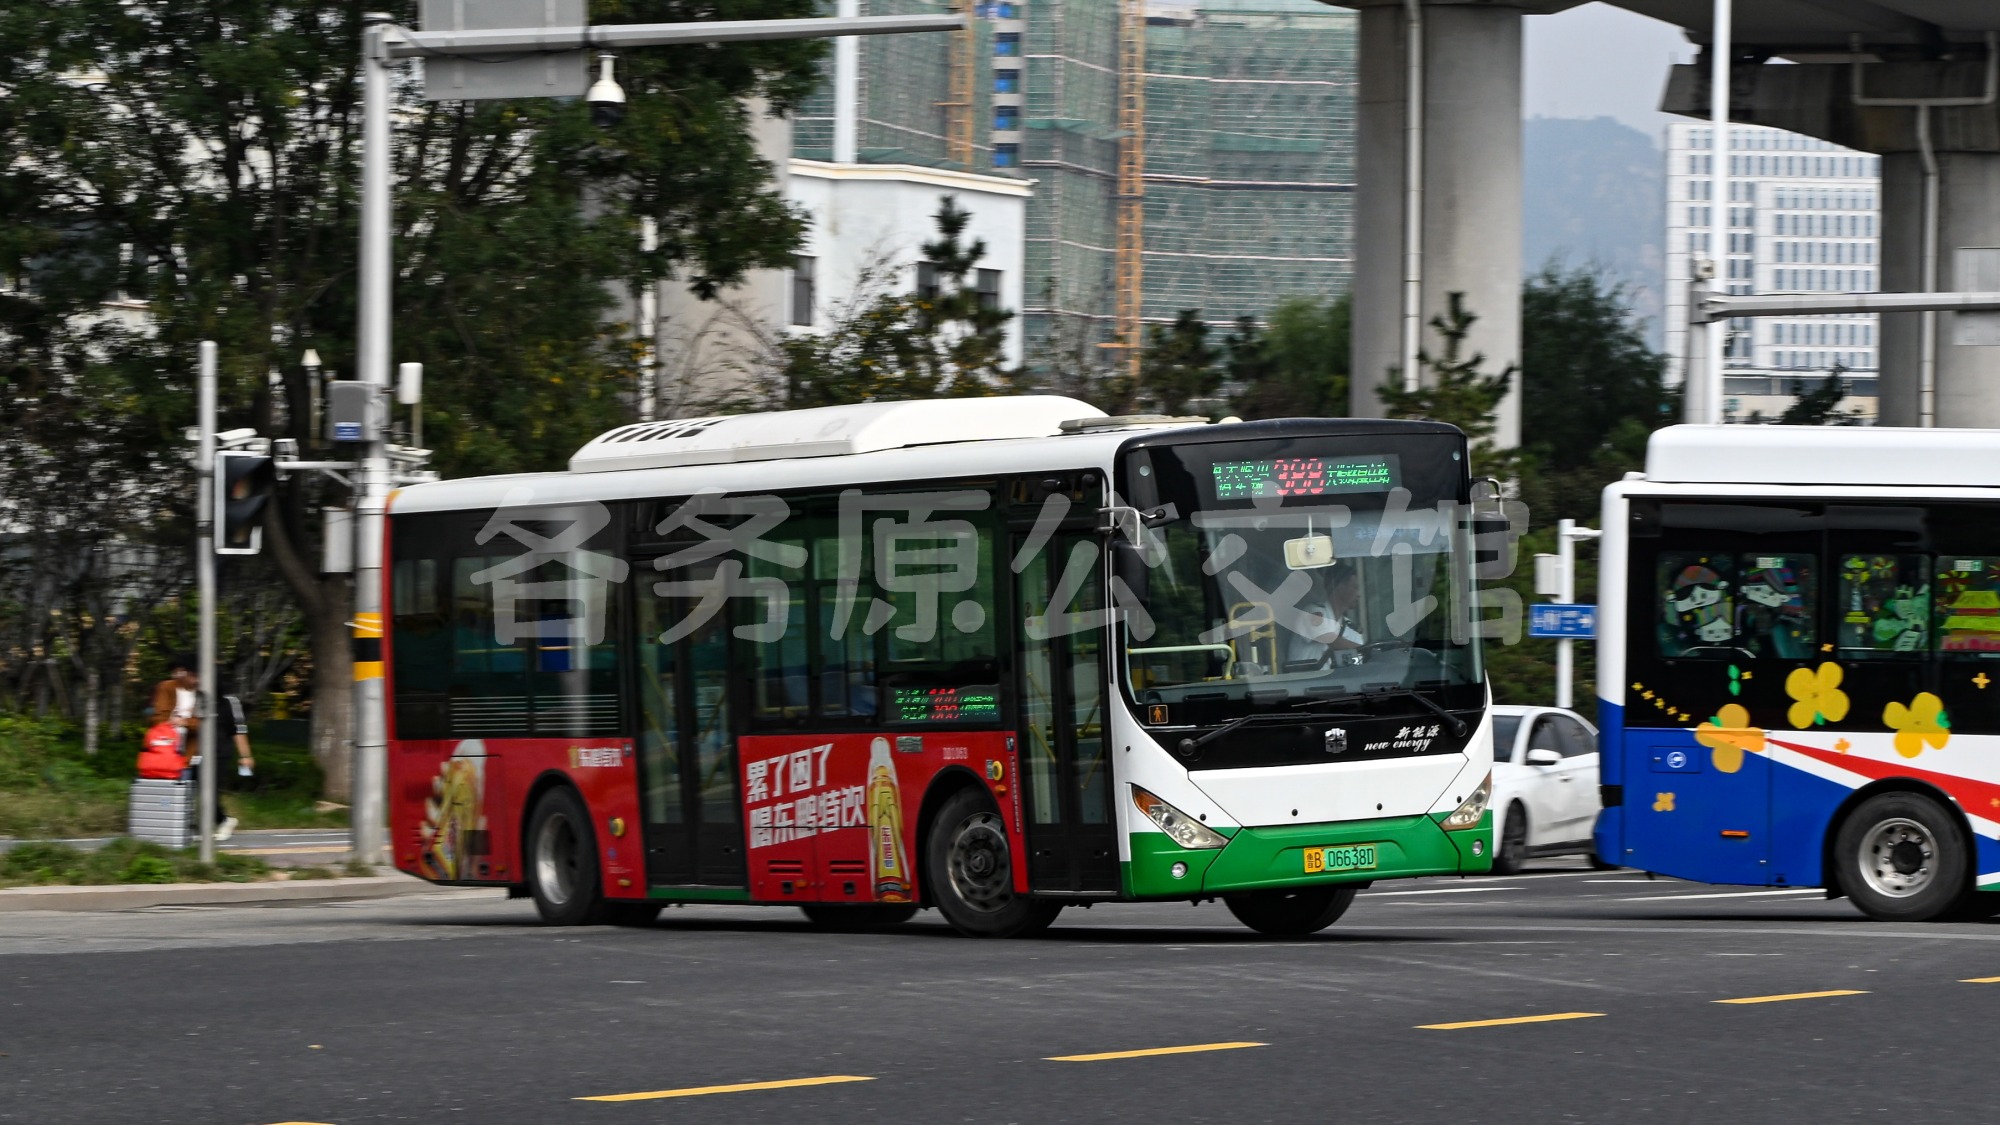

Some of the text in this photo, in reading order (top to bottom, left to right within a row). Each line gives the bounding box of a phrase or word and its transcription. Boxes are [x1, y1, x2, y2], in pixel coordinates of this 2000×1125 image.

[1364, 738, 1433, 753] new energy
[1395, 724, 1441, 740] 新能源
[746, 743, 834, 803] 累了困了
[749, 785, 866, 850] 喝东鹏特饮
